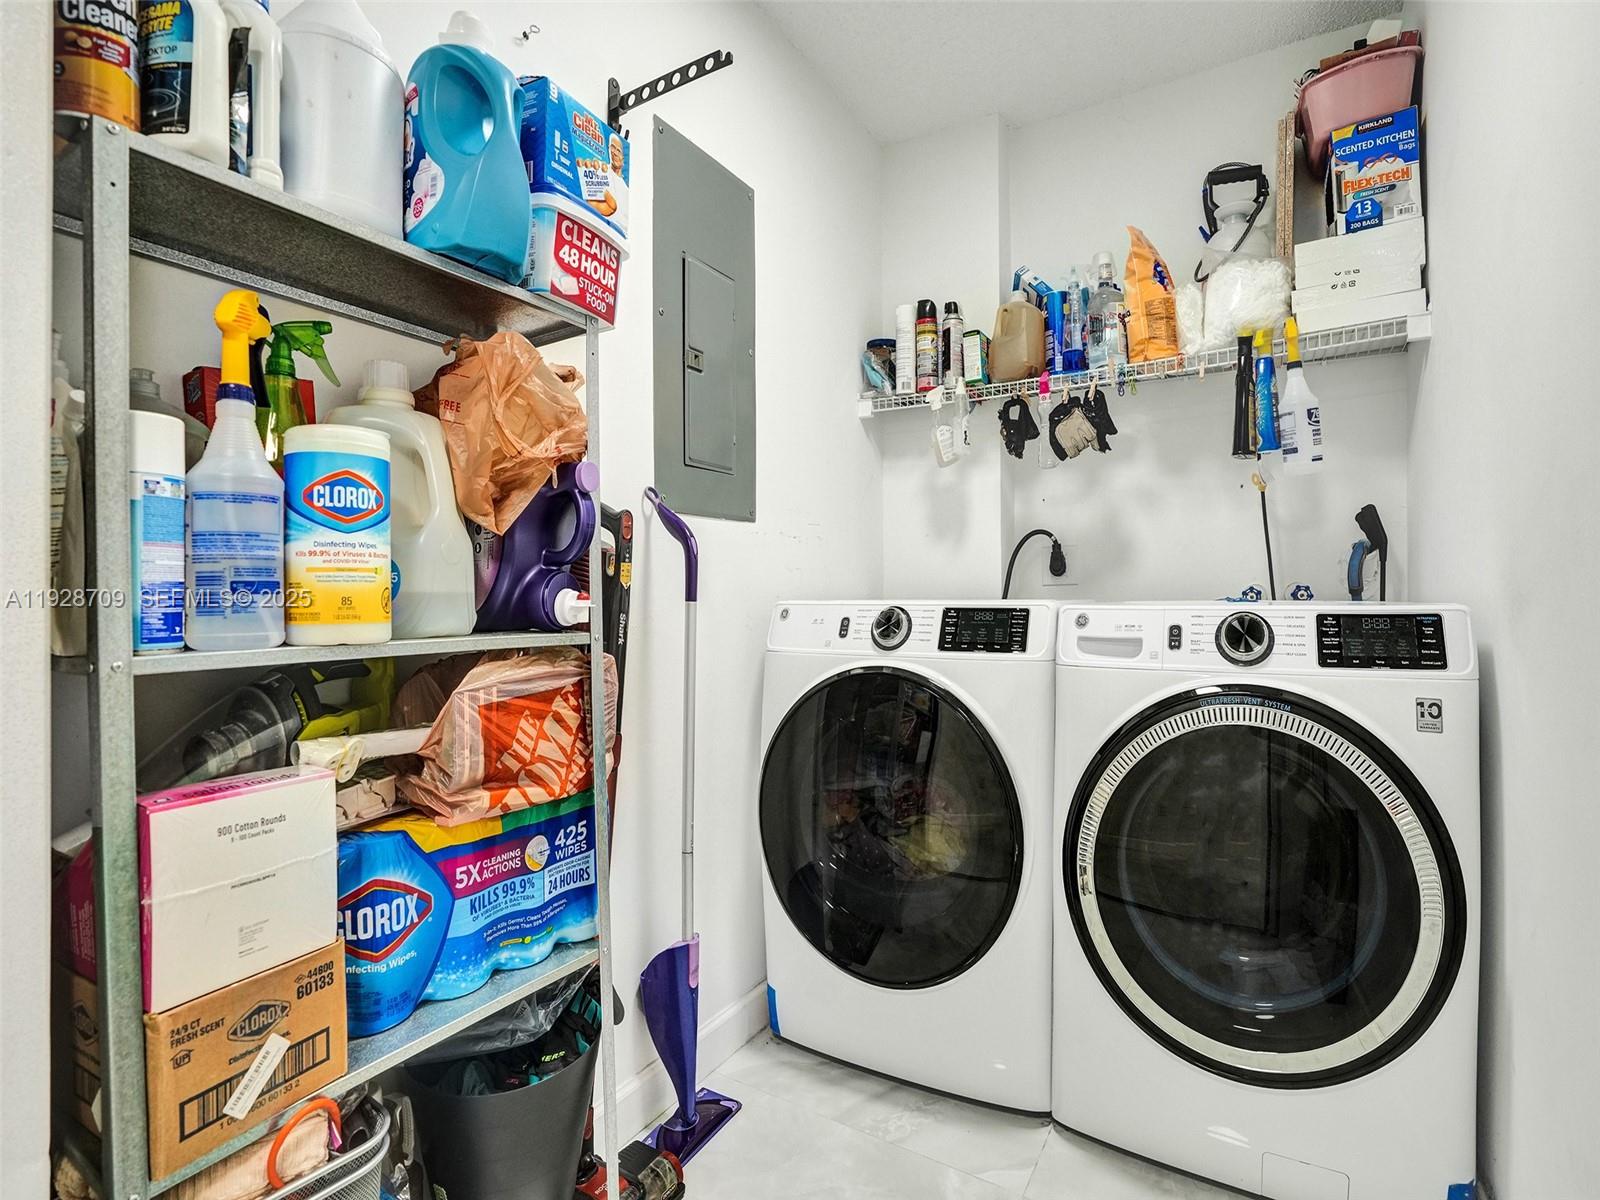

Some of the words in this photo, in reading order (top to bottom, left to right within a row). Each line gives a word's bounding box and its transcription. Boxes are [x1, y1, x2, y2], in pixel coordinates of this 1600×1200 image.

[573, 111, 605, 147] Clean
[1358, 116, 1393, 131] KIRKLAND
[1335, 140, 1375, 157] SCENTED
[1376, 129, 1415, 147] KITCHEN
[1398, 141, 1416, 152] Bags
[583, 169, 600, 181] 40%
[1355, 200, 1372, 215] 13
[1362, 217, 1379, 227] BAGS
[561, 219, 617, 269] CLEANS
[559, 244, 579, 269] 48
[580, 253, 616, 291] HOUR
[578, 276, 614, 306] STUCK-ON
[586, 292, 607, 313] FOOD
[312, 485, 377, 510] CLOROX
[307, 549, 332, 558] 99.9%
[313, 540, 357, 550] Disinfecting
[357, 541, 377, 550] Wipes
[340, 596, 353, 606] 85
[617, 612, 627, 645] Shark
[1199, 695, 1240, 708] ULTRAFRESH
[1243, 697, 1261, 706] VENT
[1264, 700, 1292, 712] SYSTEM
[1416, 701, 1442, 720] 10
[496, 709, 541, 774] THE
[216, 824, 233, 838] 900
[234, 819, 260, 835] Cotton
[260, 813, 287, 829] Rounds
[554, 819, 588, 848] 425
[482, 848, 521, 868] CLEANING
[554, 840, 588, 861] WIPES
[455, 860, 482, 890] 5X
[481, 857, 522, 881] ACTIONS
[548, 876, 558, 896] 24
[559, 865, 591, 889] HOURS
[469, 886, 500, 916] KILLS
[501, 876, 536, 900] 99.9%
[472, 914, 480, 922] OF
[508, 894, 536, 905] BACTERIA
[507, 924, 520, 932] More
[520, 922, 533, 930] Than
[306, 960, 334, 980] 44600
[345, 961, 388, 975] nfecting
[296, 971, 335, 1000] 60133
[169, 1023, 189, 1040] 24/9
[190, 1017, 202, 1031] CT
[170, 1031, 199, 1049] FRESH
[199, 1016, 226, 1037] SCENT
[235, 1004, 283, 1038] CLOROX
[174, 1054, 191, 1068] UP
[294, 1079, 301, 1089] 2
